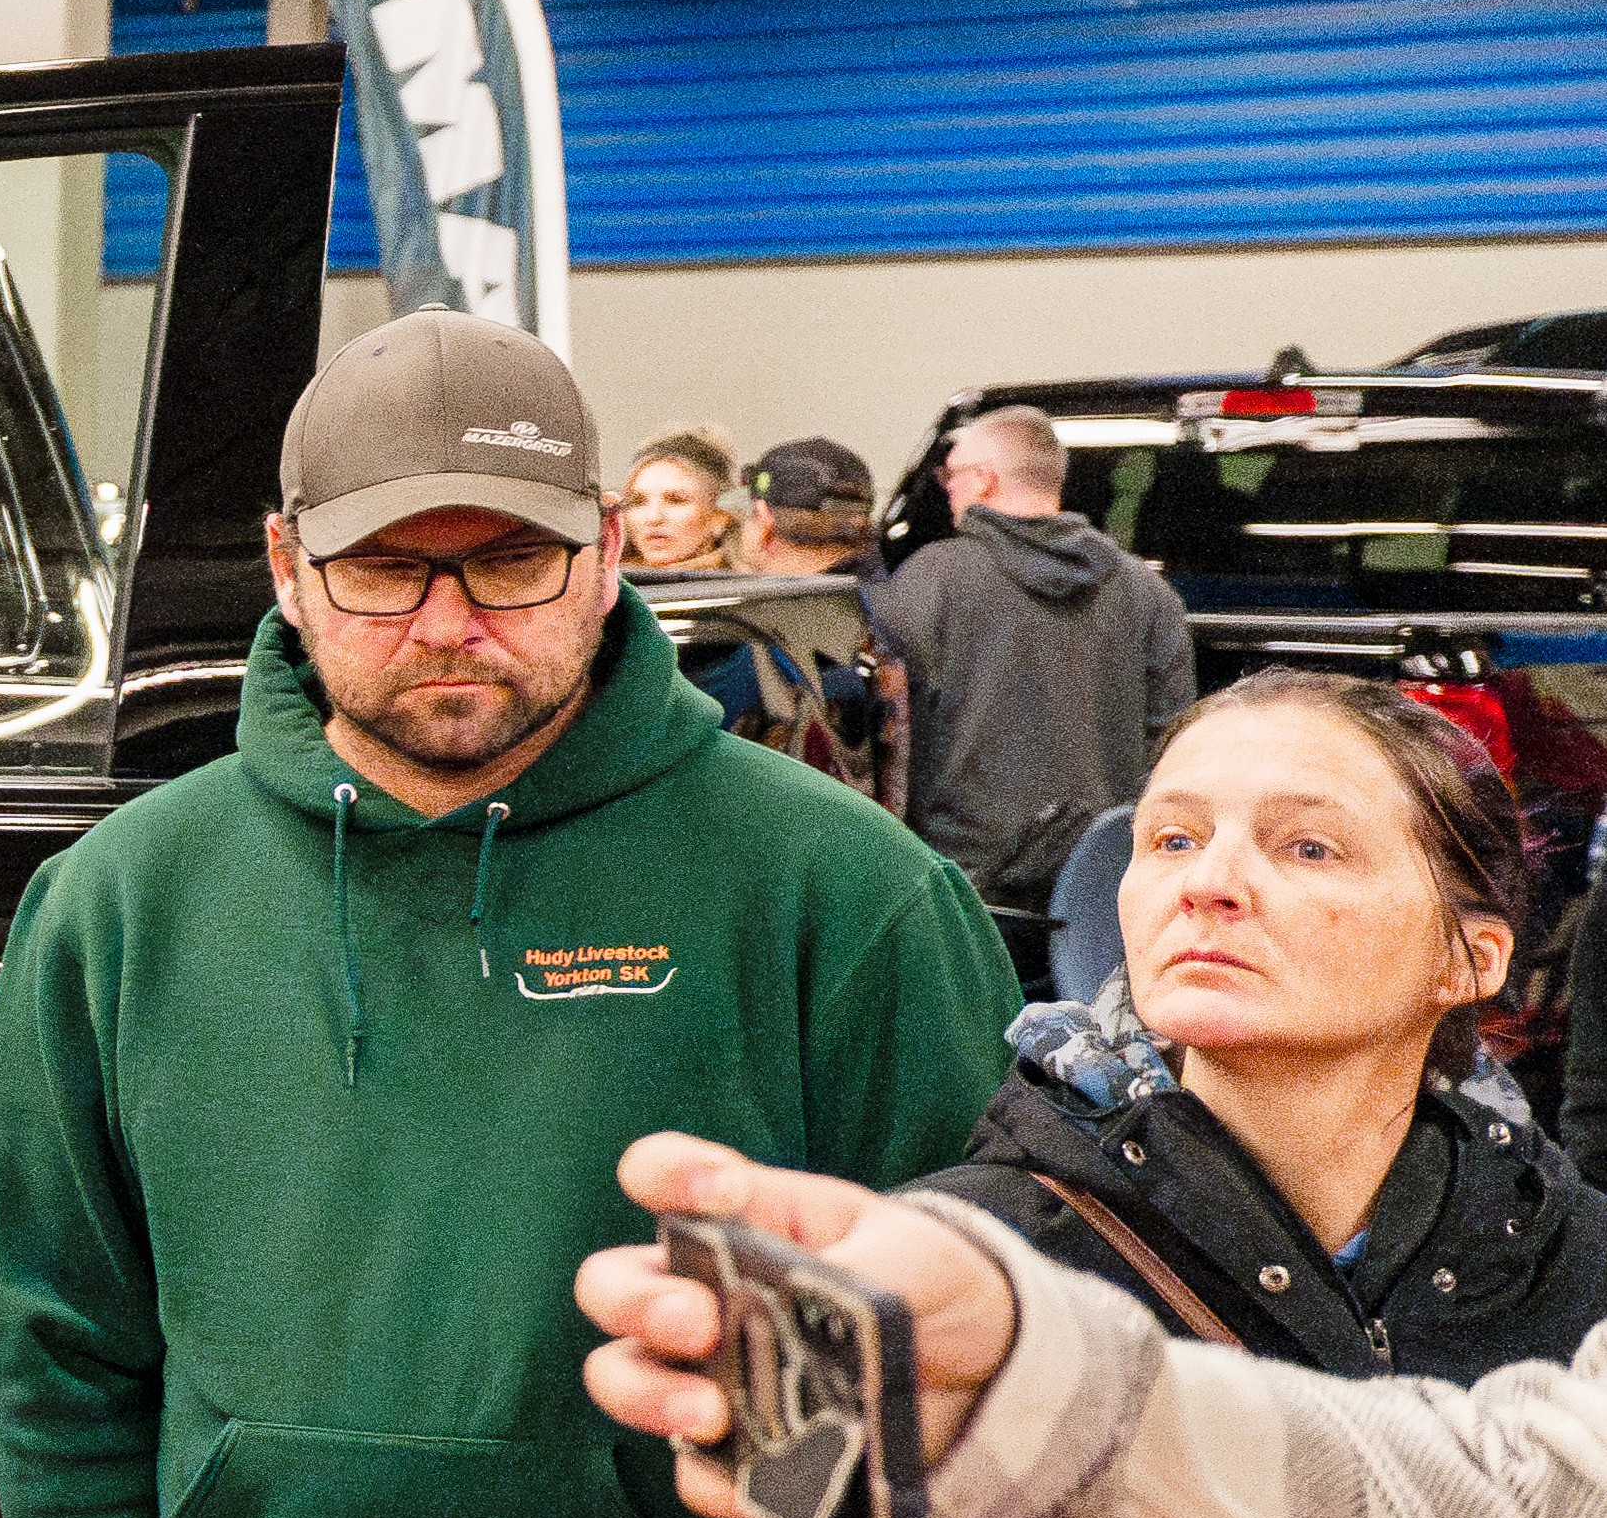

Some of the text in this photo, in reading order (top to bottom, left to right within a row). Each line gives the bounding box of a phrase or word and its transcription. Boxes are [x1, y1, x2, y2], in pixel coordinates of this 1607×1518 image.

[525, 944, 670, 968] Hudy Livestock
[544, 966, 650, 987] Yorkton SK
